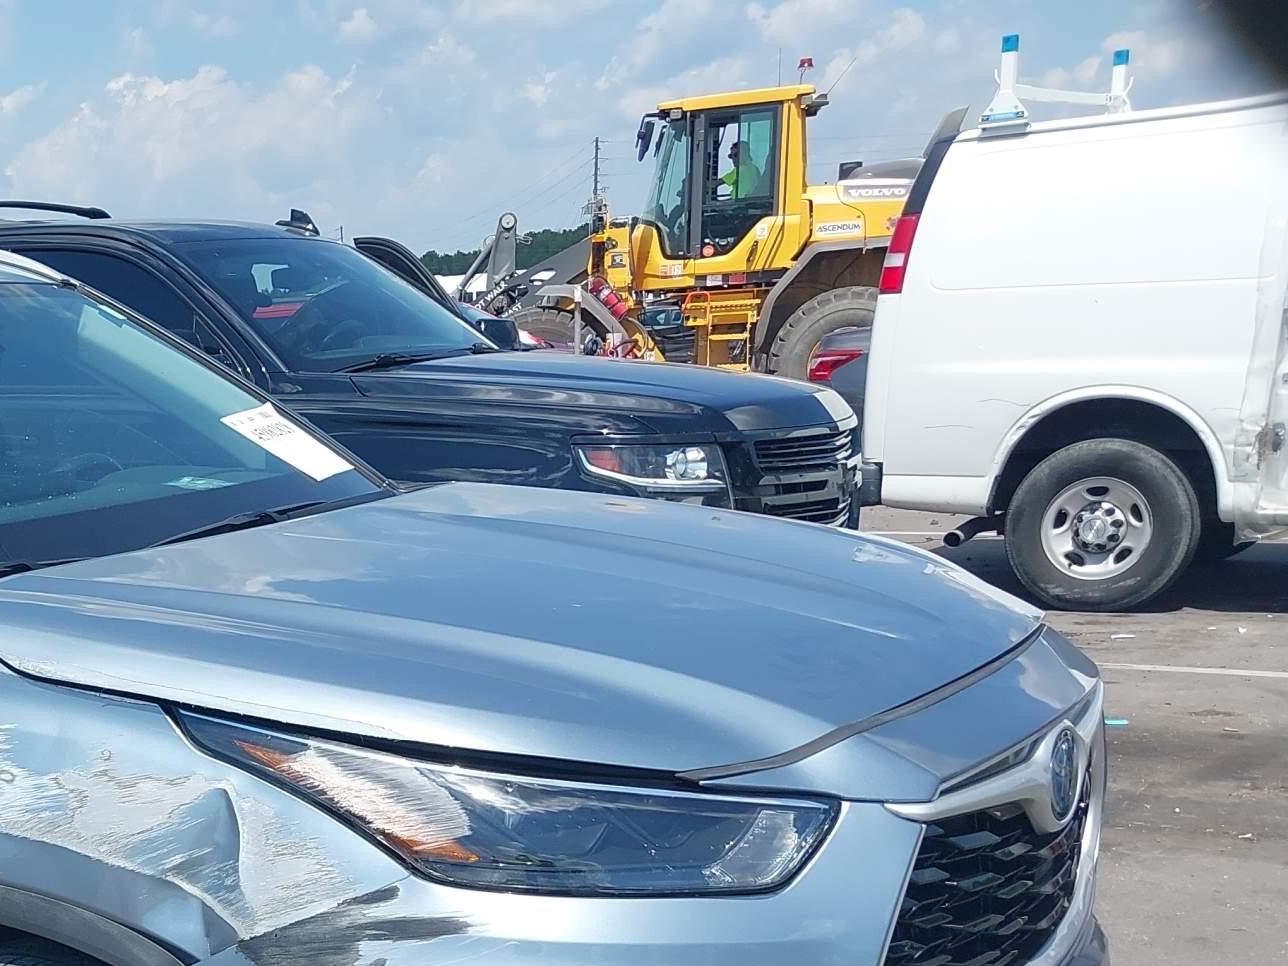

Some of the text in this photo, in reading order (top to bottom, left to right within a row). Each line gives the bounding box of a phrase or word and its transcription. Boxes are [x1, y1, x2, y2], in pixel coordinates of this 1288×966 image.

[848, 188, 906, 197] VOLVO
[816, 223, 861, 233] ASCENDUM
[485, 281, 508, 301] WALK
